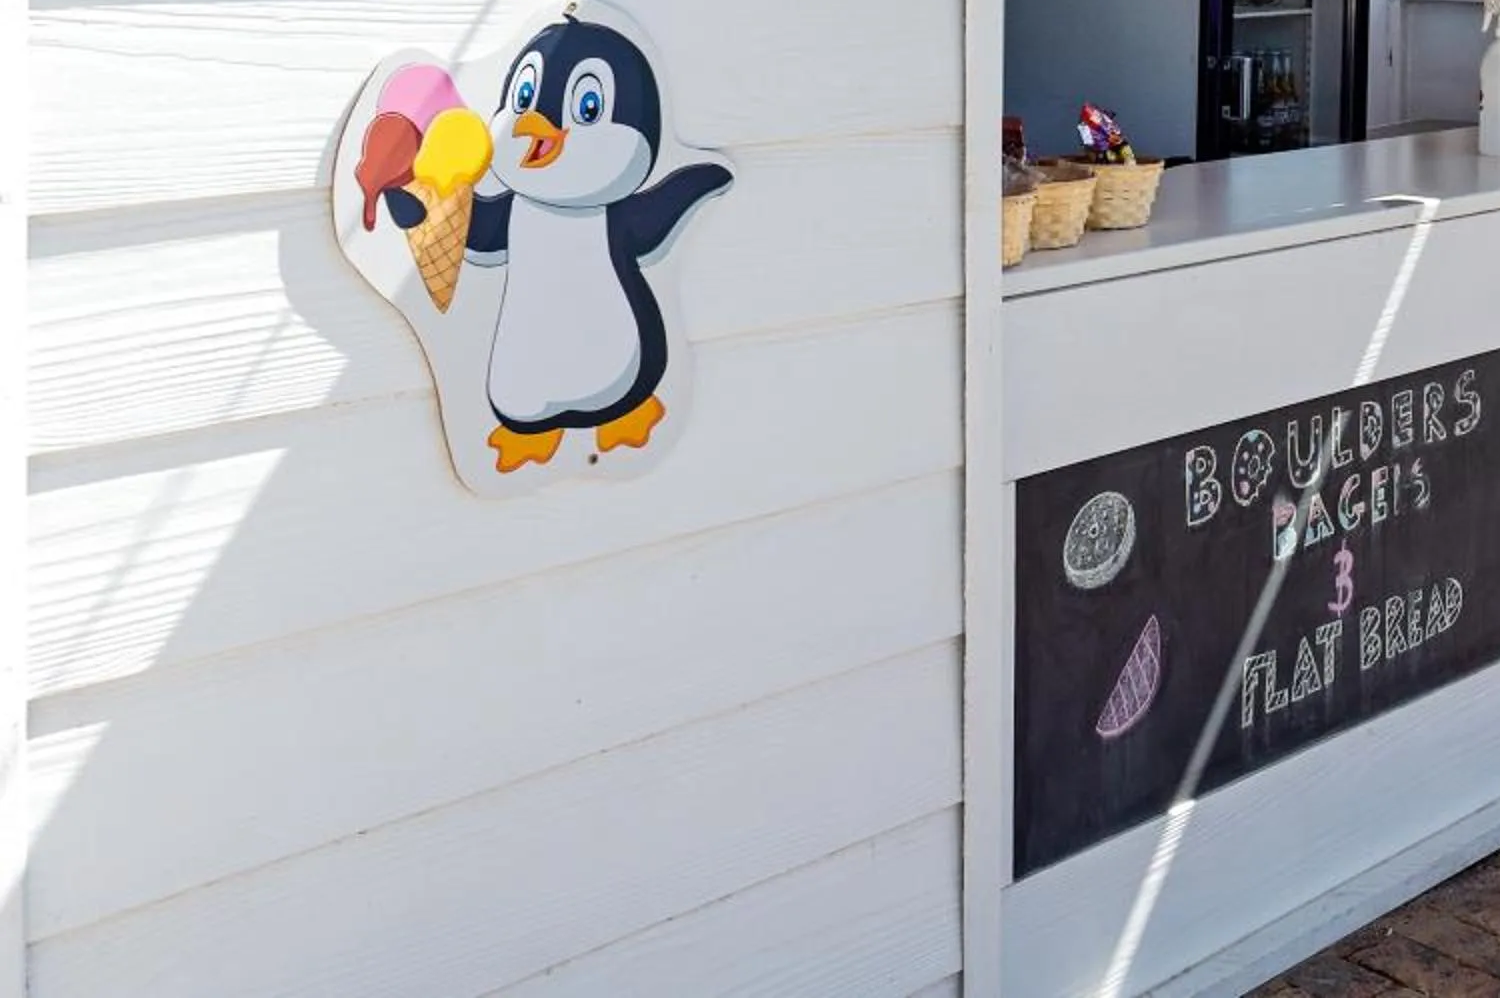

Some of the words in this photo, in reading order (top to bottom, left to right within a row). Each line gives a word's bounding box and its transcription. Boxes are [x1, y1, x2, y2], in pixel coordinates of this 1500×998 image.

[1185, 370, 1482, 527] BOULDERS
[1241, 618, 1344, 730] FLAT
[1360, 576, 1464, 672] BREAD
